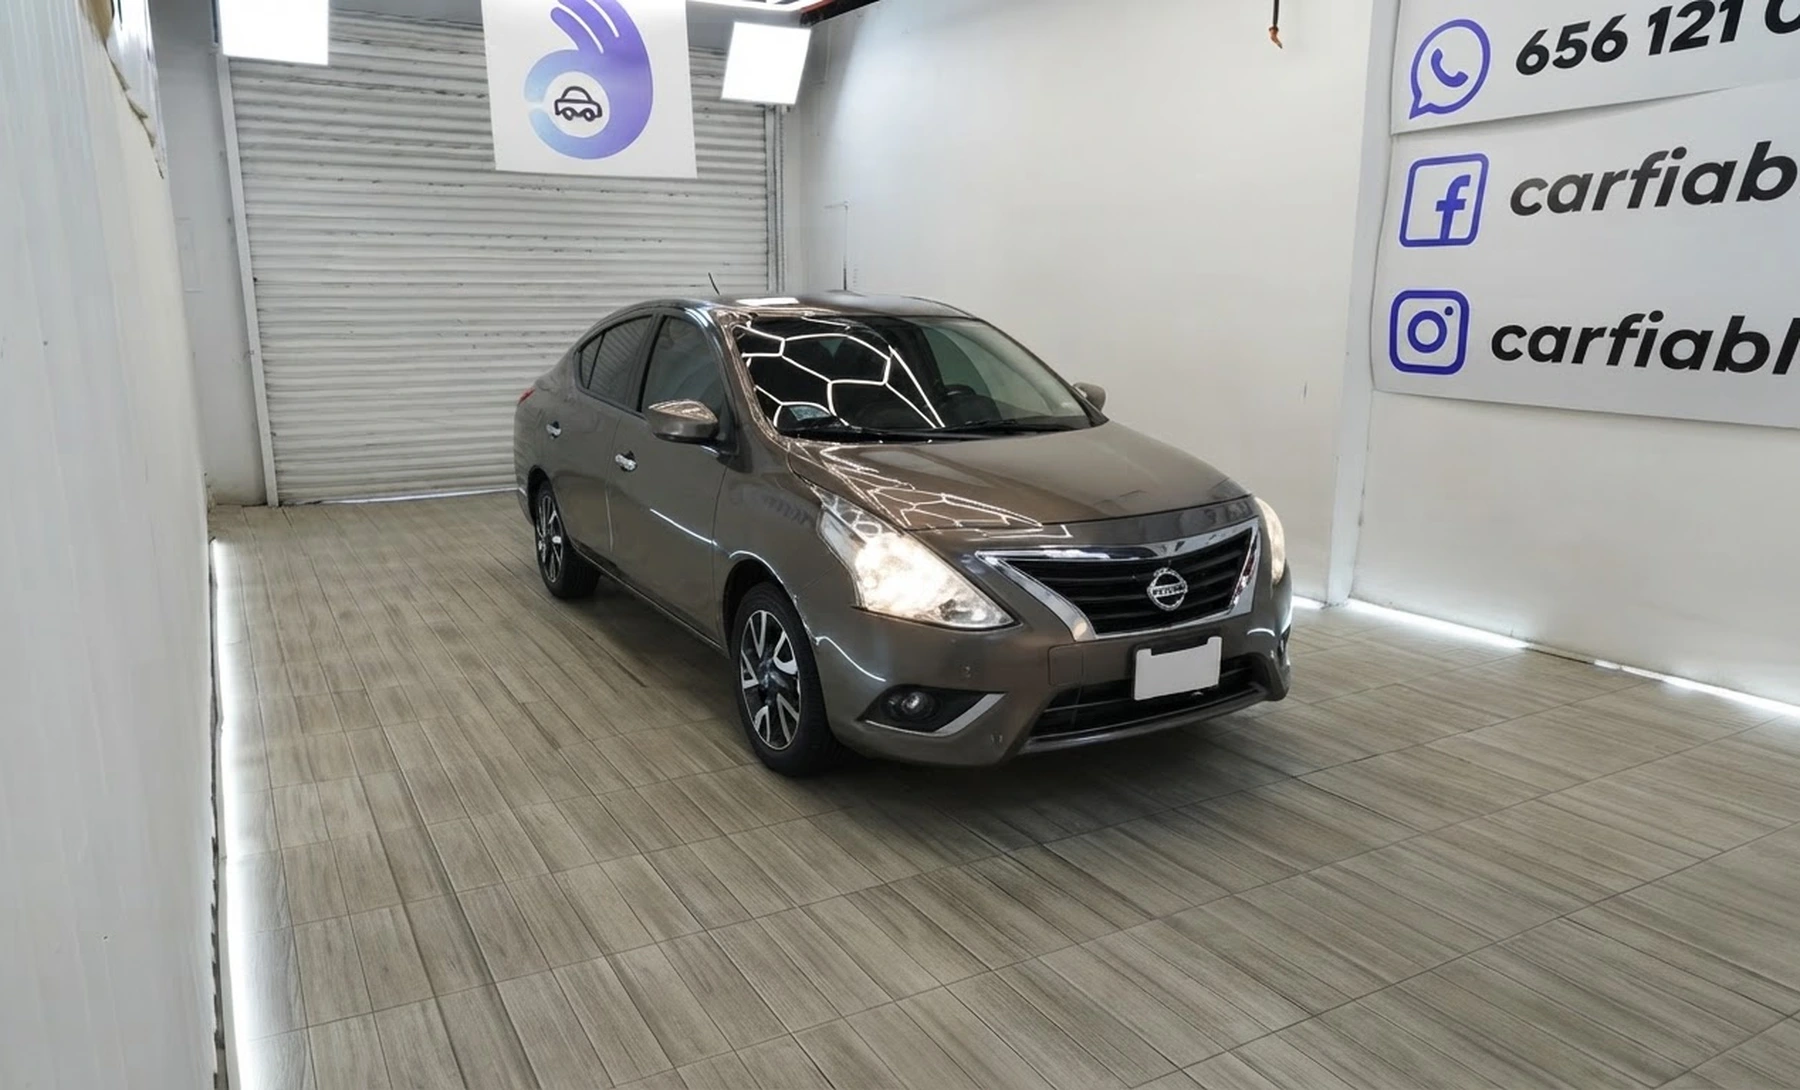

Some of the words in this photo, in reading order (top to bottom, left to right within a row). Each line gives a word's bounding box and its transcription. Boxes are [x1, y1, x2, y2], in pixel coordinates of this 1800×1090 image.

[1515, 13, 1628, 76] 656
[1647, 0, 1744, 56] 121
[1510, 140, 1798, 216] carfiab
[1491, 310, 1800, 375] carfiabl
